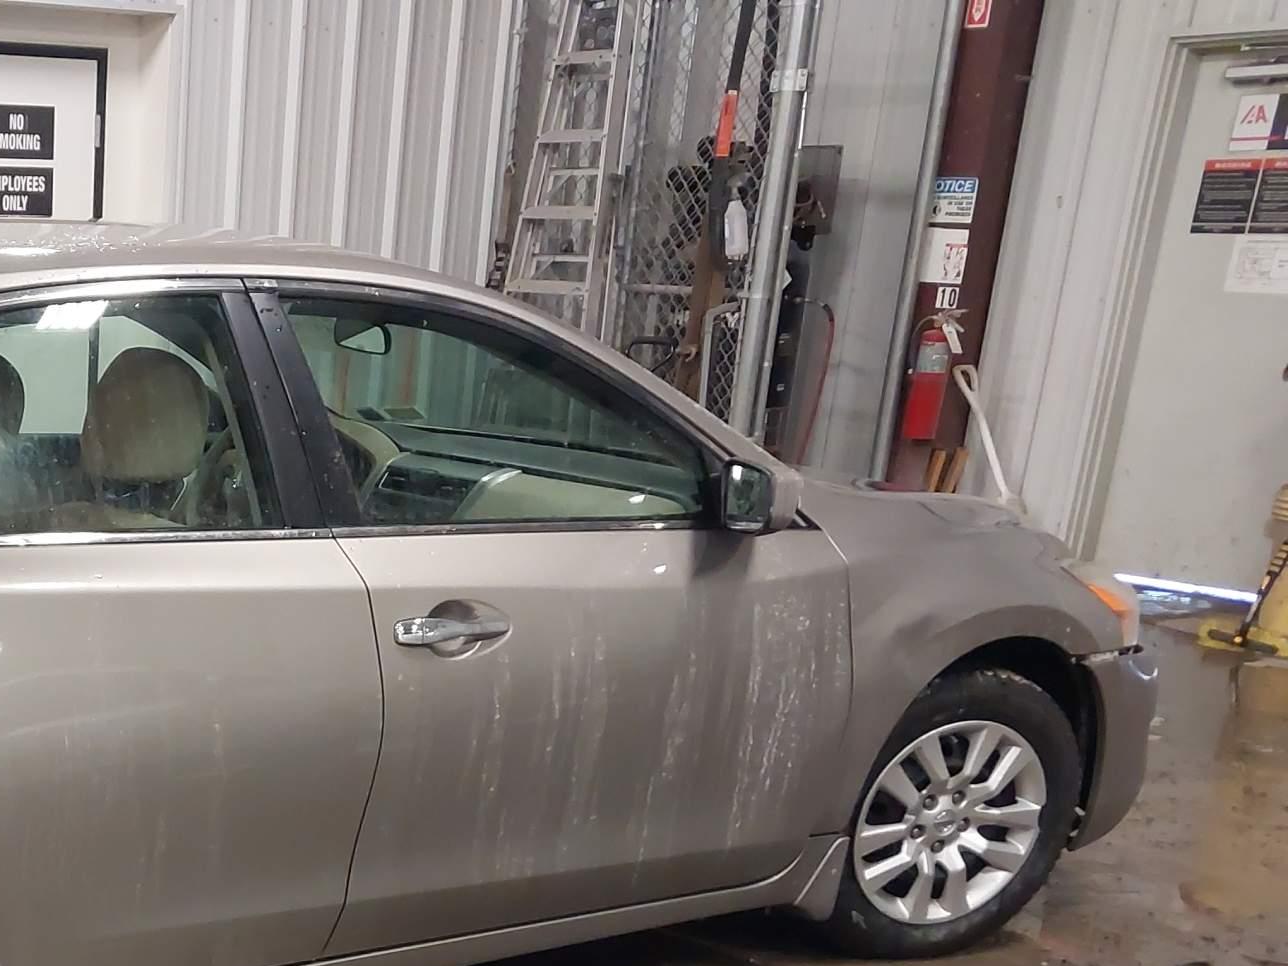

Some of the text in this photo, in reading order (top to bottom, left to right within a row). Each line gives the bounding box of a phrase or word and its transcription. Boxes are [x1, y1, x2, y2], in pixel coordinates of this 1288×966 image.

[9, 114, 24, 130] NO
[935, 180, 975, 192] OTICE
[2, 195, 28, 211] ONLY
[940, 288, 957, 307] 10
